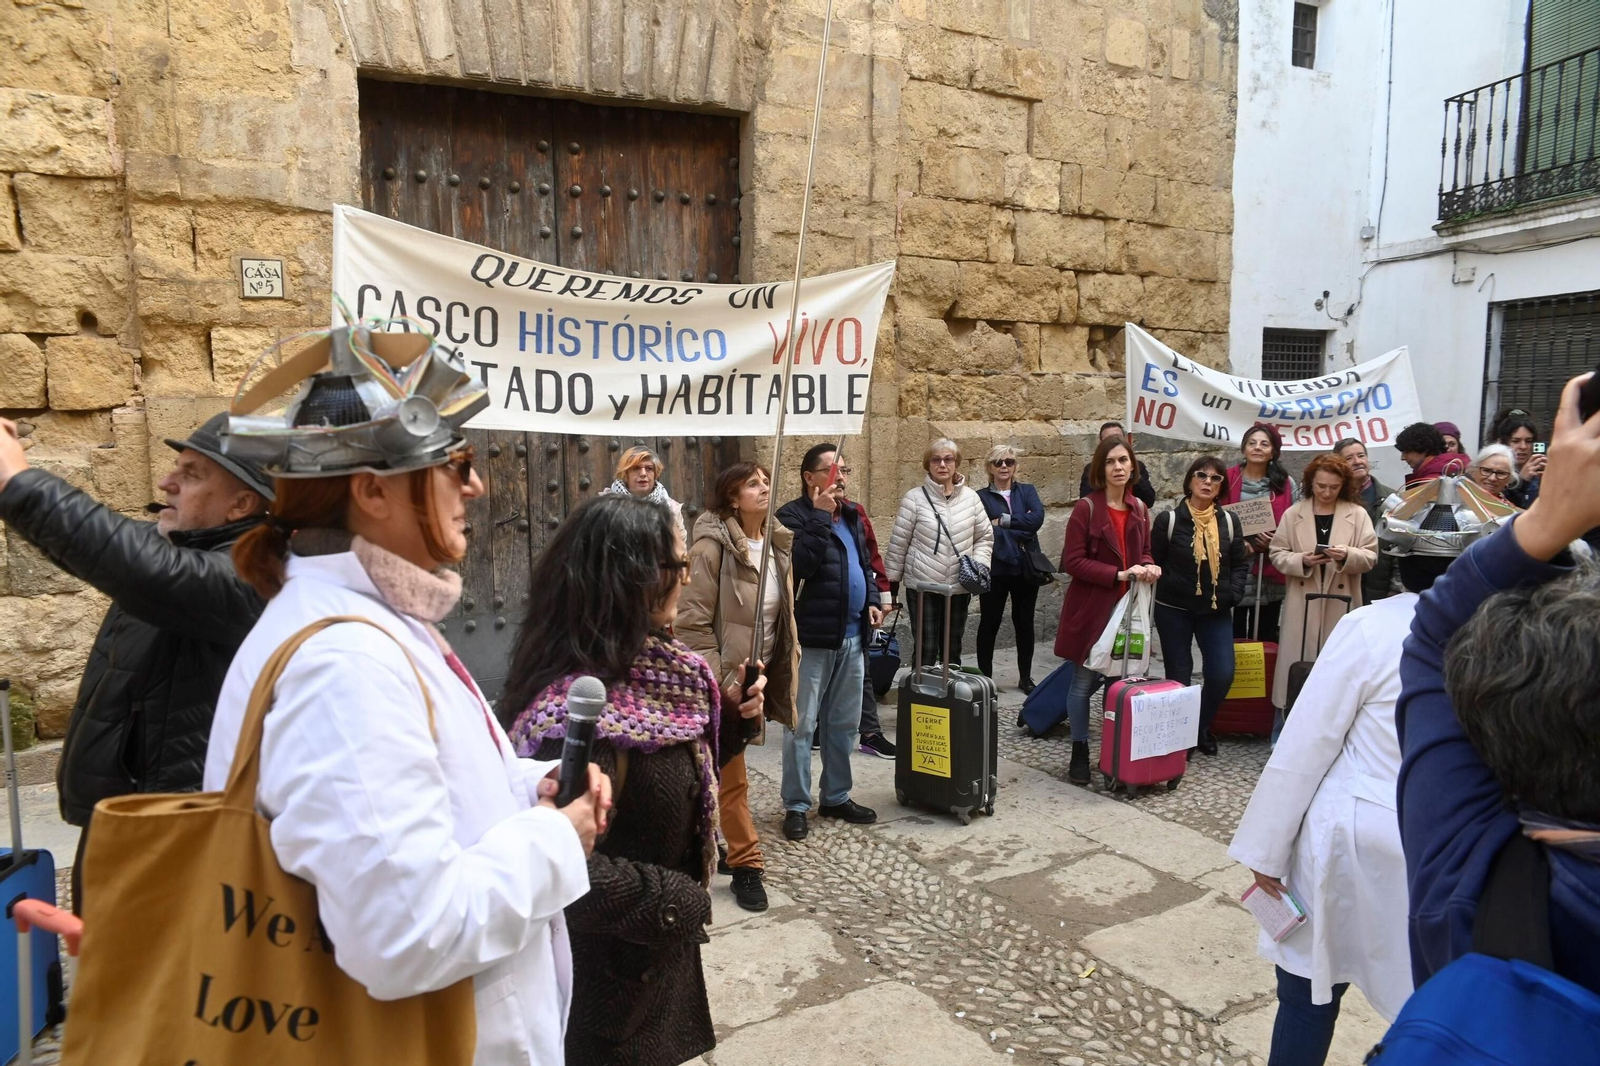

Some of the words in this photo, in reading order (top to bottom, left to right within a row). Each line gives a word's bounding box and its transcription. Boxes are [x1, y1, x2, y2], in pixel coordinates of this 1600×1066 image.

[244, 267, 281, 279] CASA
[471, 253, 703, 305] QUEREMOS
[728, 284, 781, 309] UN
[265, 279, 275, 295] 5
[357, 284, 499, 347] CASCO
[1172, 352, 1204, 377] LA
[457, 351, 594, 416] TADO
[1141, 362, 1179, 397] ES
[1258, 382, 1392, 420] DERECHO
[1134, 396, 1177, 430] NO
[1254, 416, 1389, 447] EGOCIO
[1242, 518, 1267, 526] TICOS
[1134, 699, 1145, 714] NO
[916, 717, 943, 726] CIERRE
[916, 731, 946, 741] VIVIENDAS
[921, 754, 936, 765] YA
[221, 883, 295, 948] We
[194, 973, 319, 1042] Love
